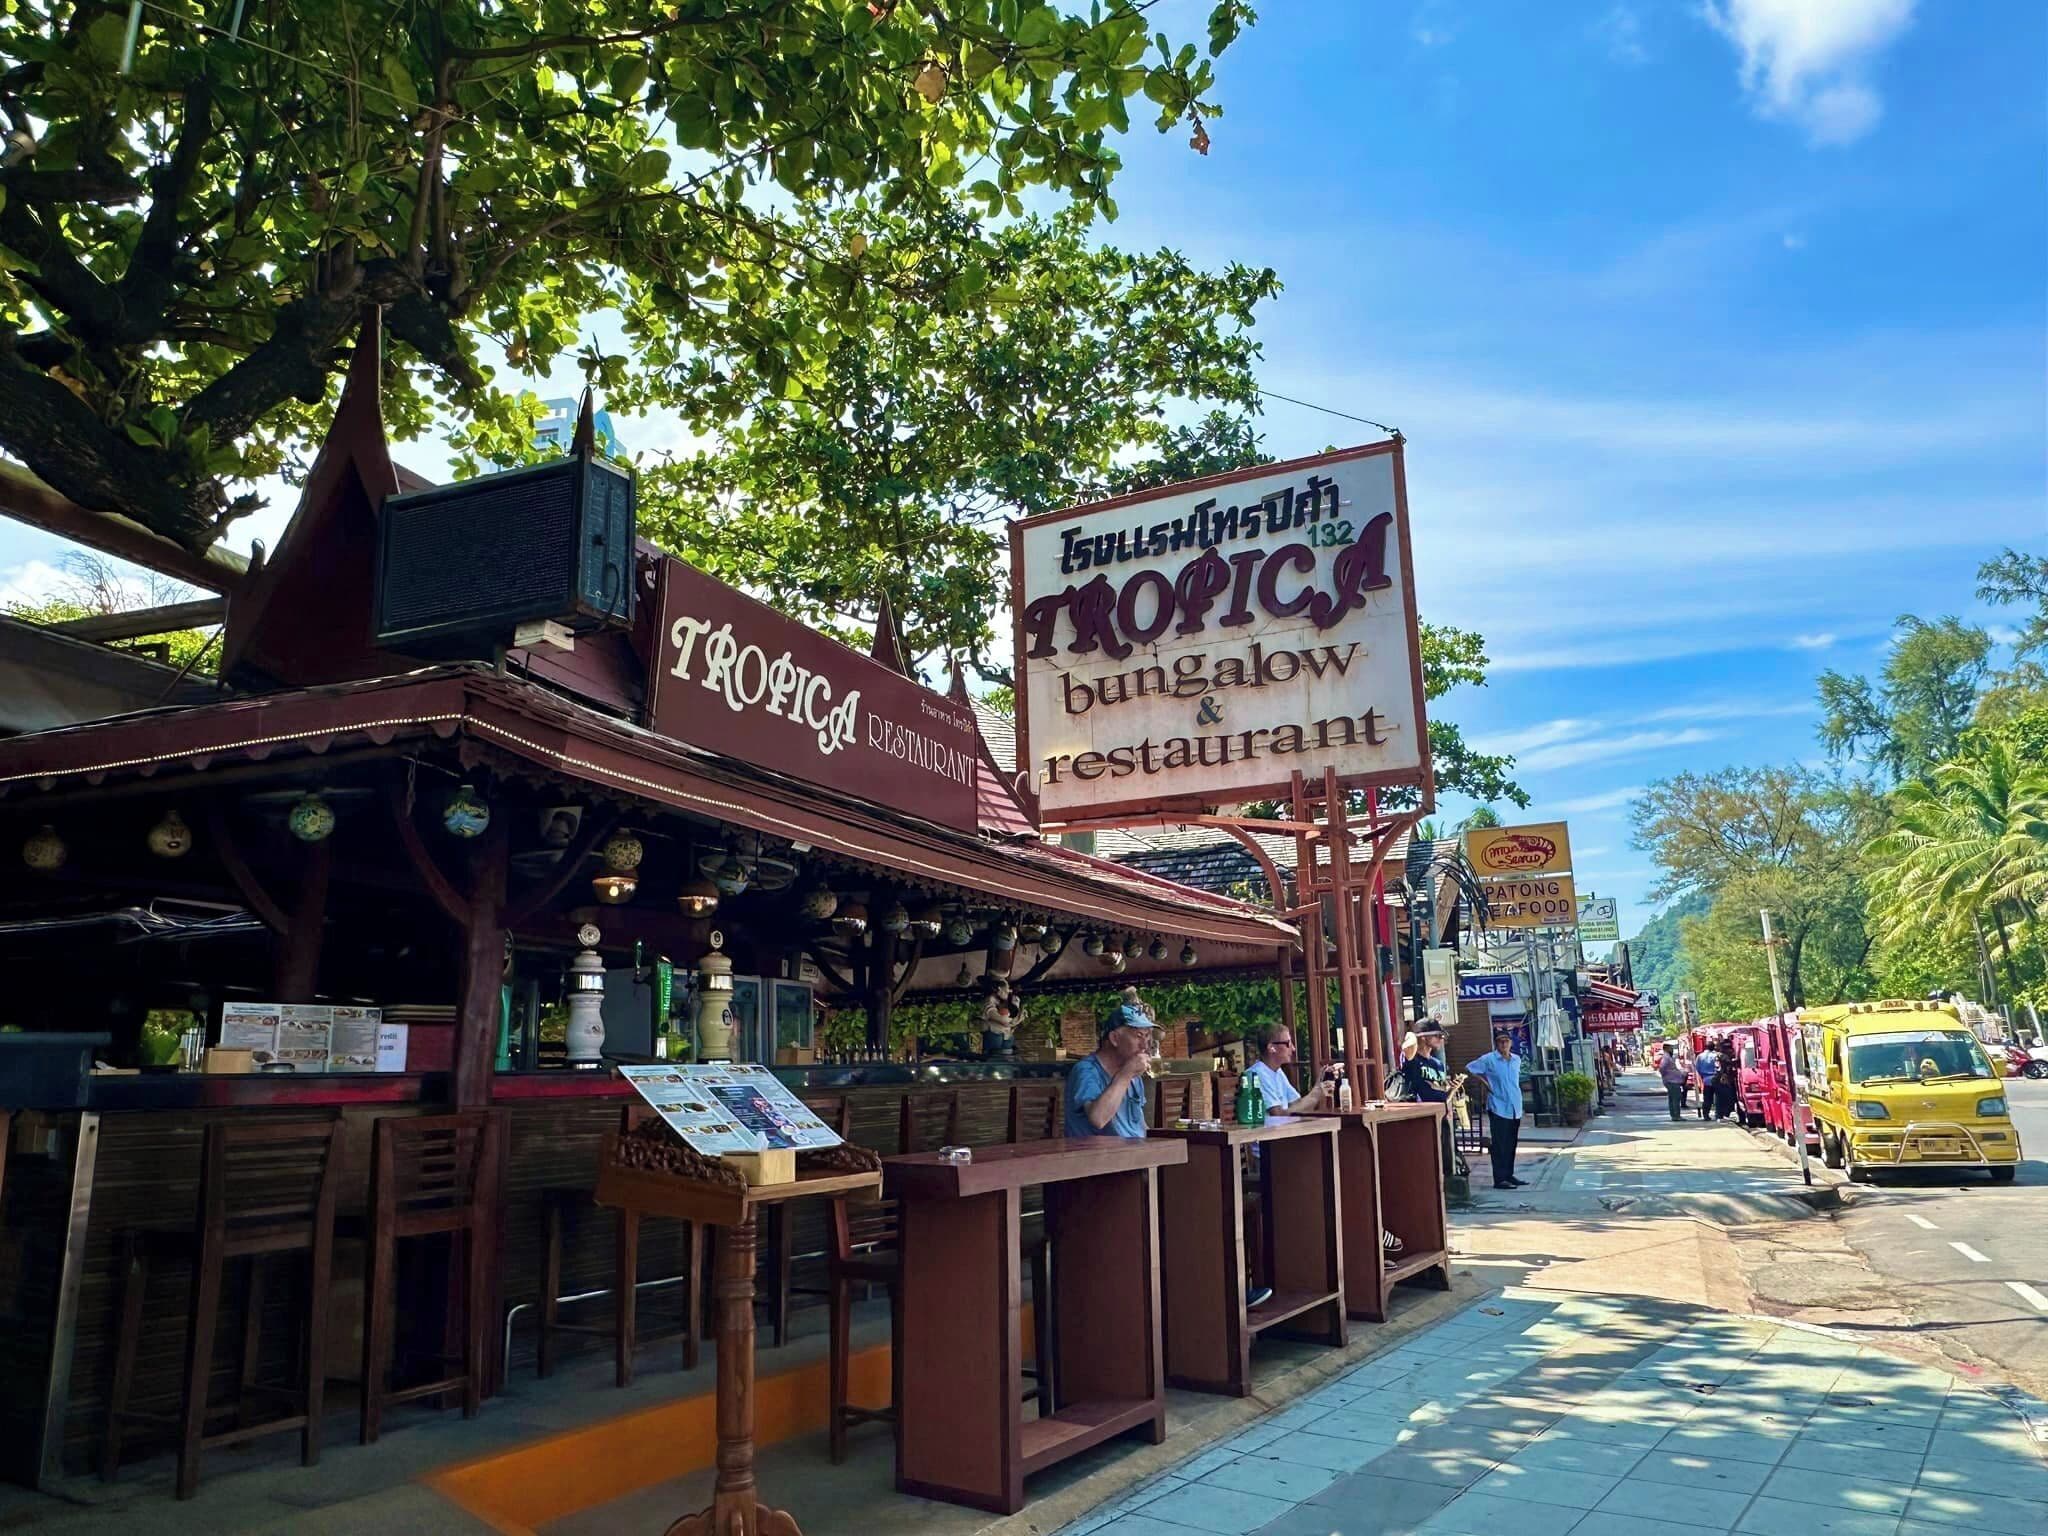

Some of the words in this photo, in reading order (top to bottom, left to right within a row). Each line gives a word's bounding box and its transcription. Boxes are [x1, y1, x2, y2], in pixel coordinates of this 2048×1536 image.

[1307, 520, 1354, 548] 132
[1022, 511, 1393, 661] TROPICA
[670, 616, 861, 755] TROPICA
[867, 711, 976, 788] RESTAURANT
[1058, 641, 1360, 716] bungalow
[1196, 695, 1224, 727] &
[1044, 706, 1388, 785] restaurant
[1485, 899, 1569, 918] EAFOOD
[1486, 882, 1560, 899] PATONG
